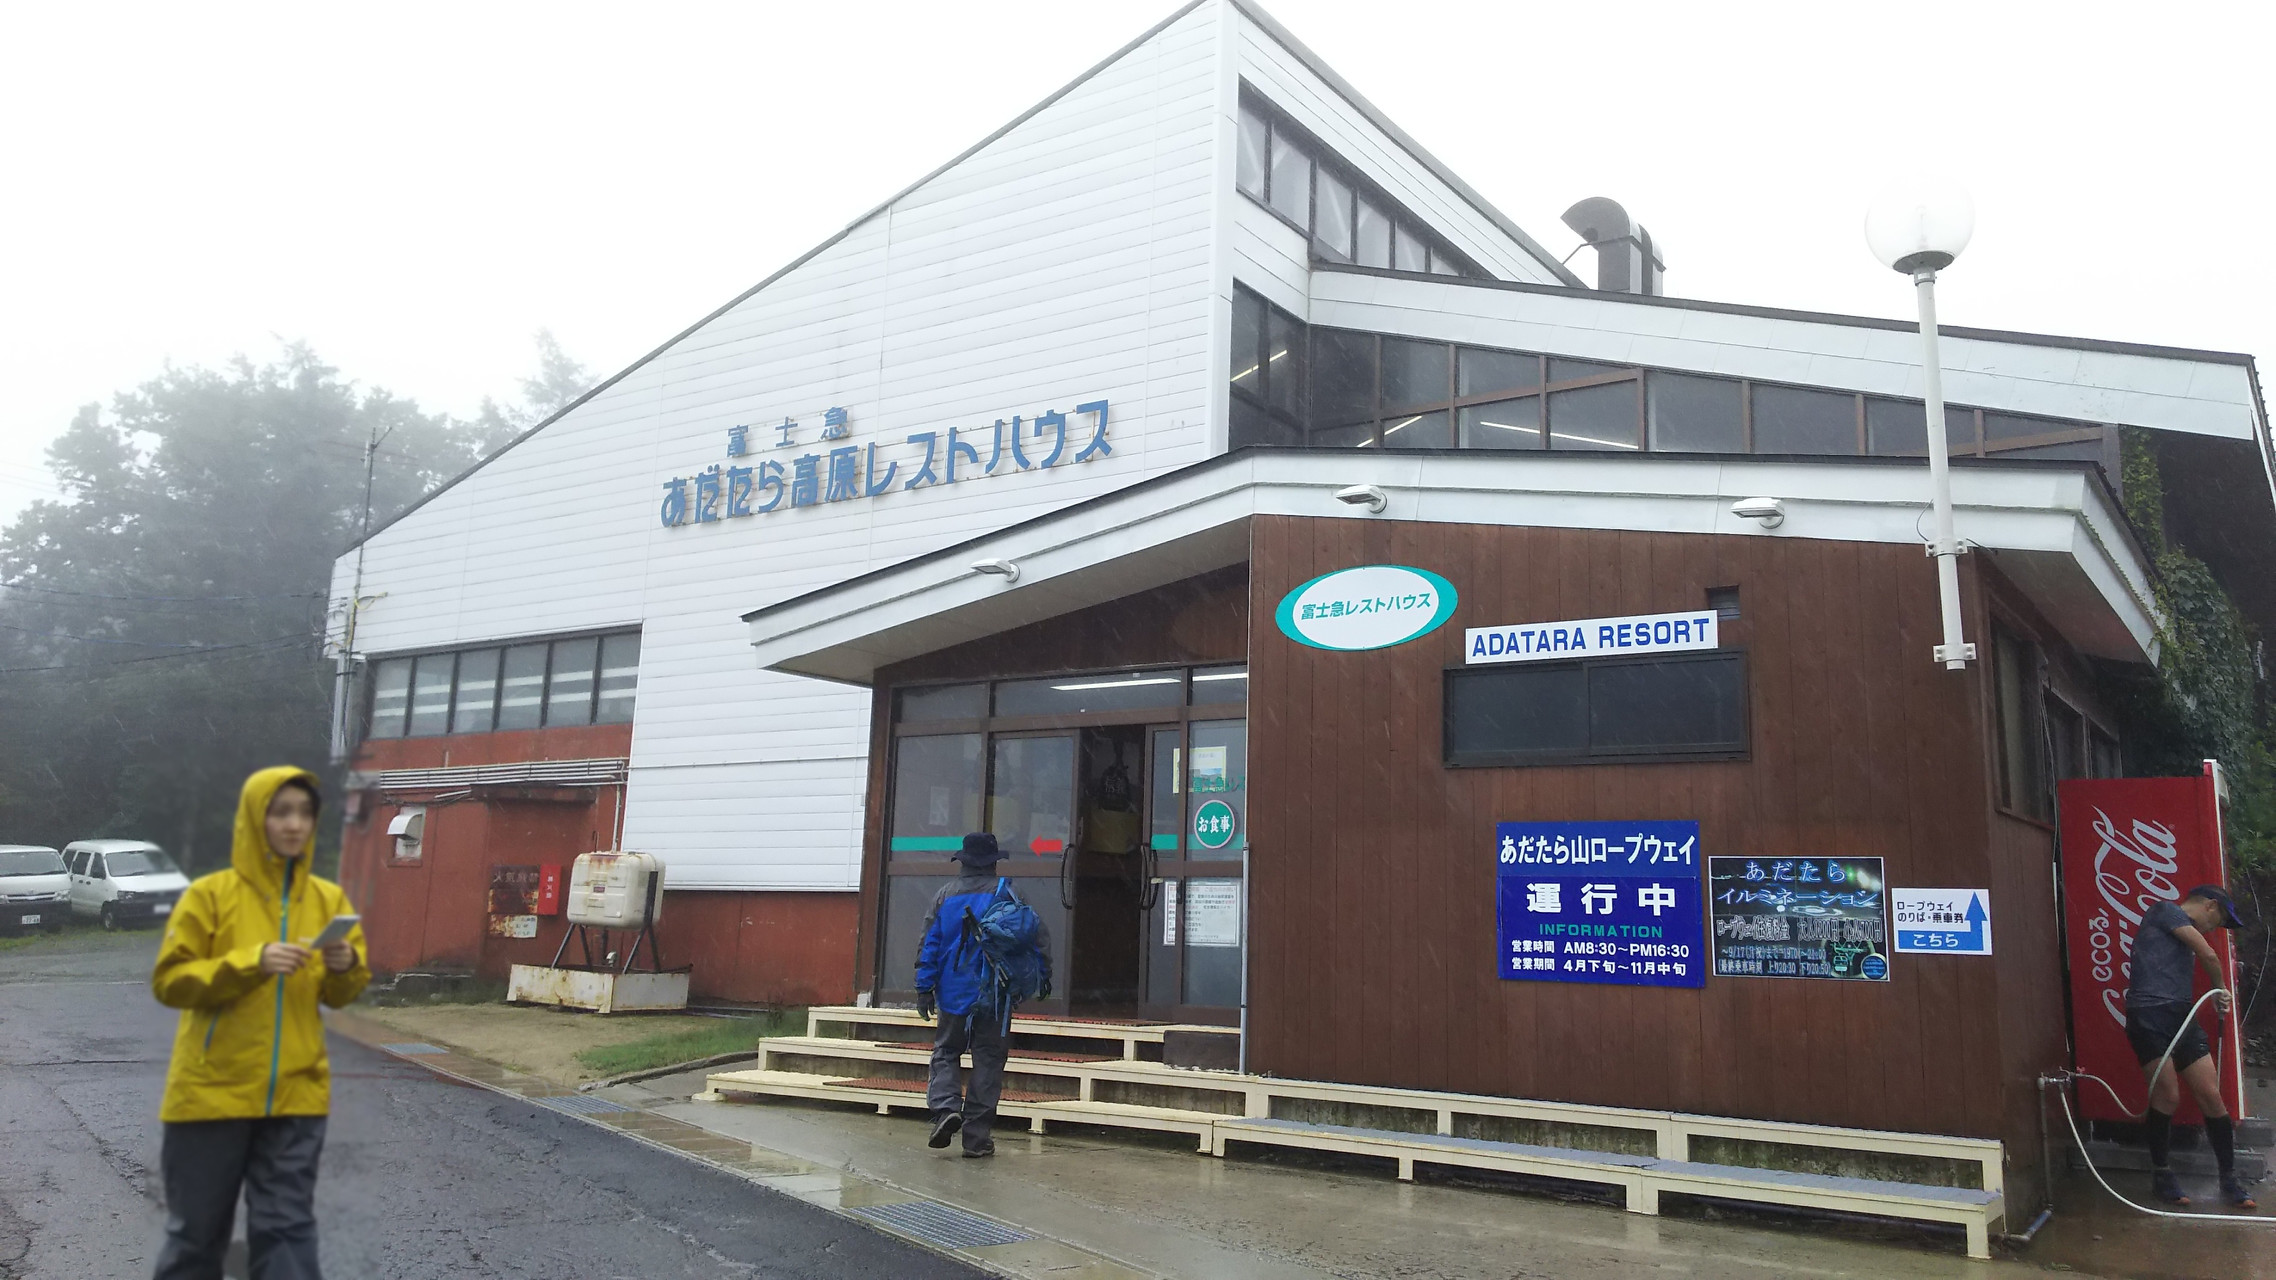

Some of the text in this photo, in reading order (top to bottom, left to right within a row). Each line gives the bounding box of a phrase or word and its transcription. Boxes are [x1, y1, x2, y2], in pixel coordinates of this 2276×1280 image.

[726, 405, 852, 458] 富士急
[660, 399, 1114, 528] あだたら高原レストハウス
[1301, 592, 1431, 621] 富士急レストハウス
[1471, 617, 1710, 658] ADATARA RESORT
[1198, 815, 1231, 834] お食事
[1500, 832, 1696, 865] あだたら山ロープウェイ
[1746, 860, 1846, 883] あだたら
[1526, 882, 1676, 917] 運行中
[1717, 888, 1879, 906] イルミネーション
[1896, 901, 1953, 912] ロープウェイ
[1897, 912, 1964, 924] のりば・乗車券
[2090, 804, 2180, 1028] -Cola
[1539, 923, 1663, 939] INFORMATION
[1913, 933, 1959, 948] こちら
[1512, 940, 1555, 954] 営業時間
[1512, 957, 1555, 971] 営業期間
